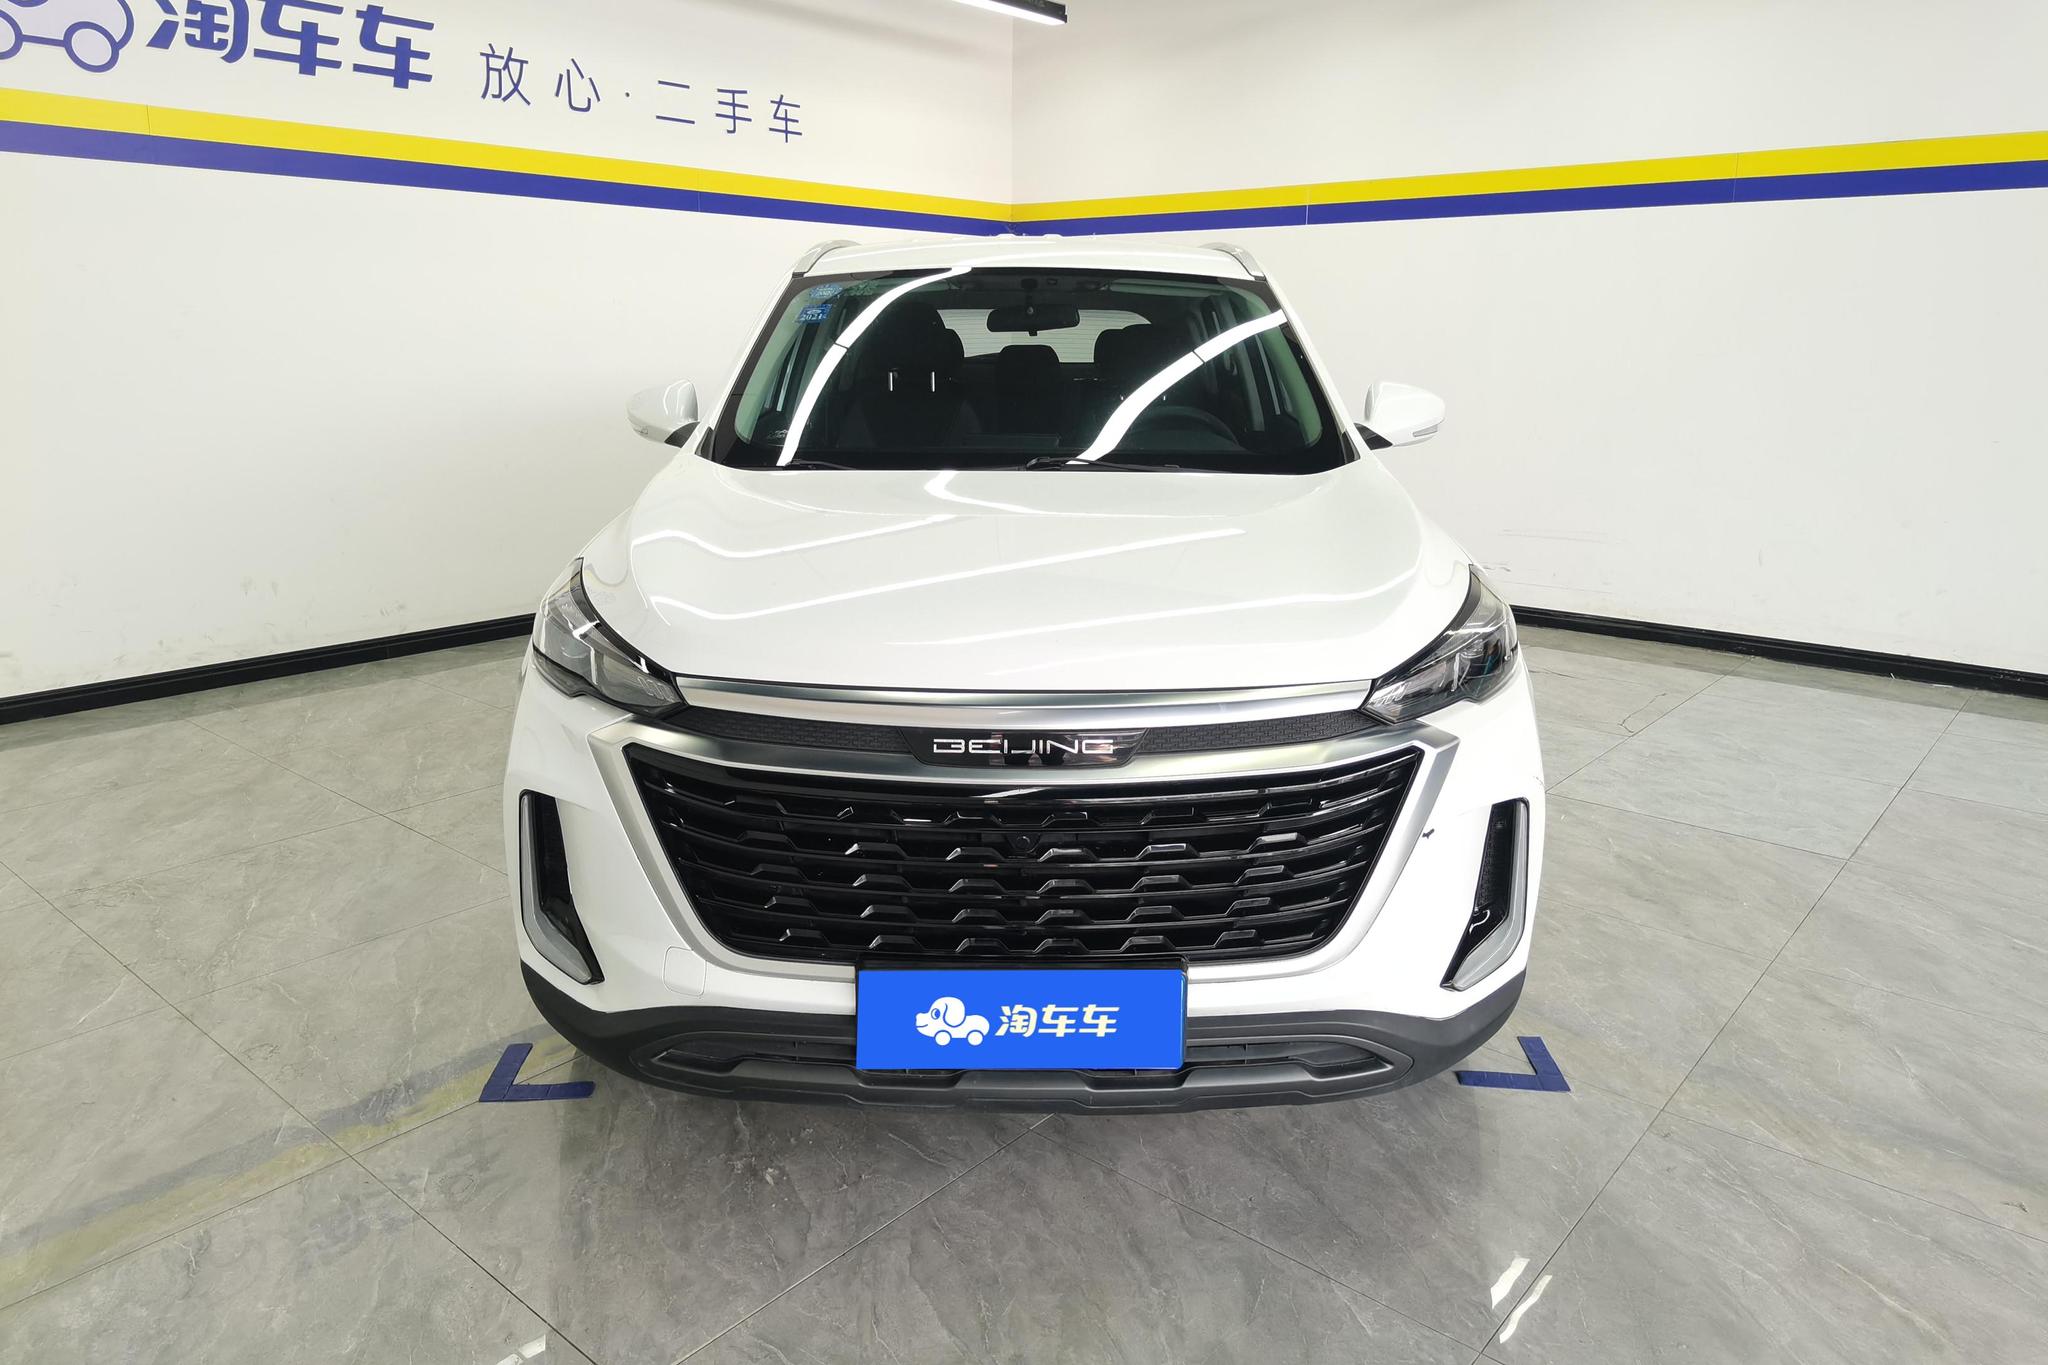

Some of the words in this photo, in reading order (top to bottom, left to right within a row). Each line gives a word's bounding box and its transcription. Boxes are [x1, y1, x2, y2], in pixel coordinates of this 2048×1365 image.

[146, 0, 435, 89] 淘车车
[933, 738, 1114, 755] BEIJING
